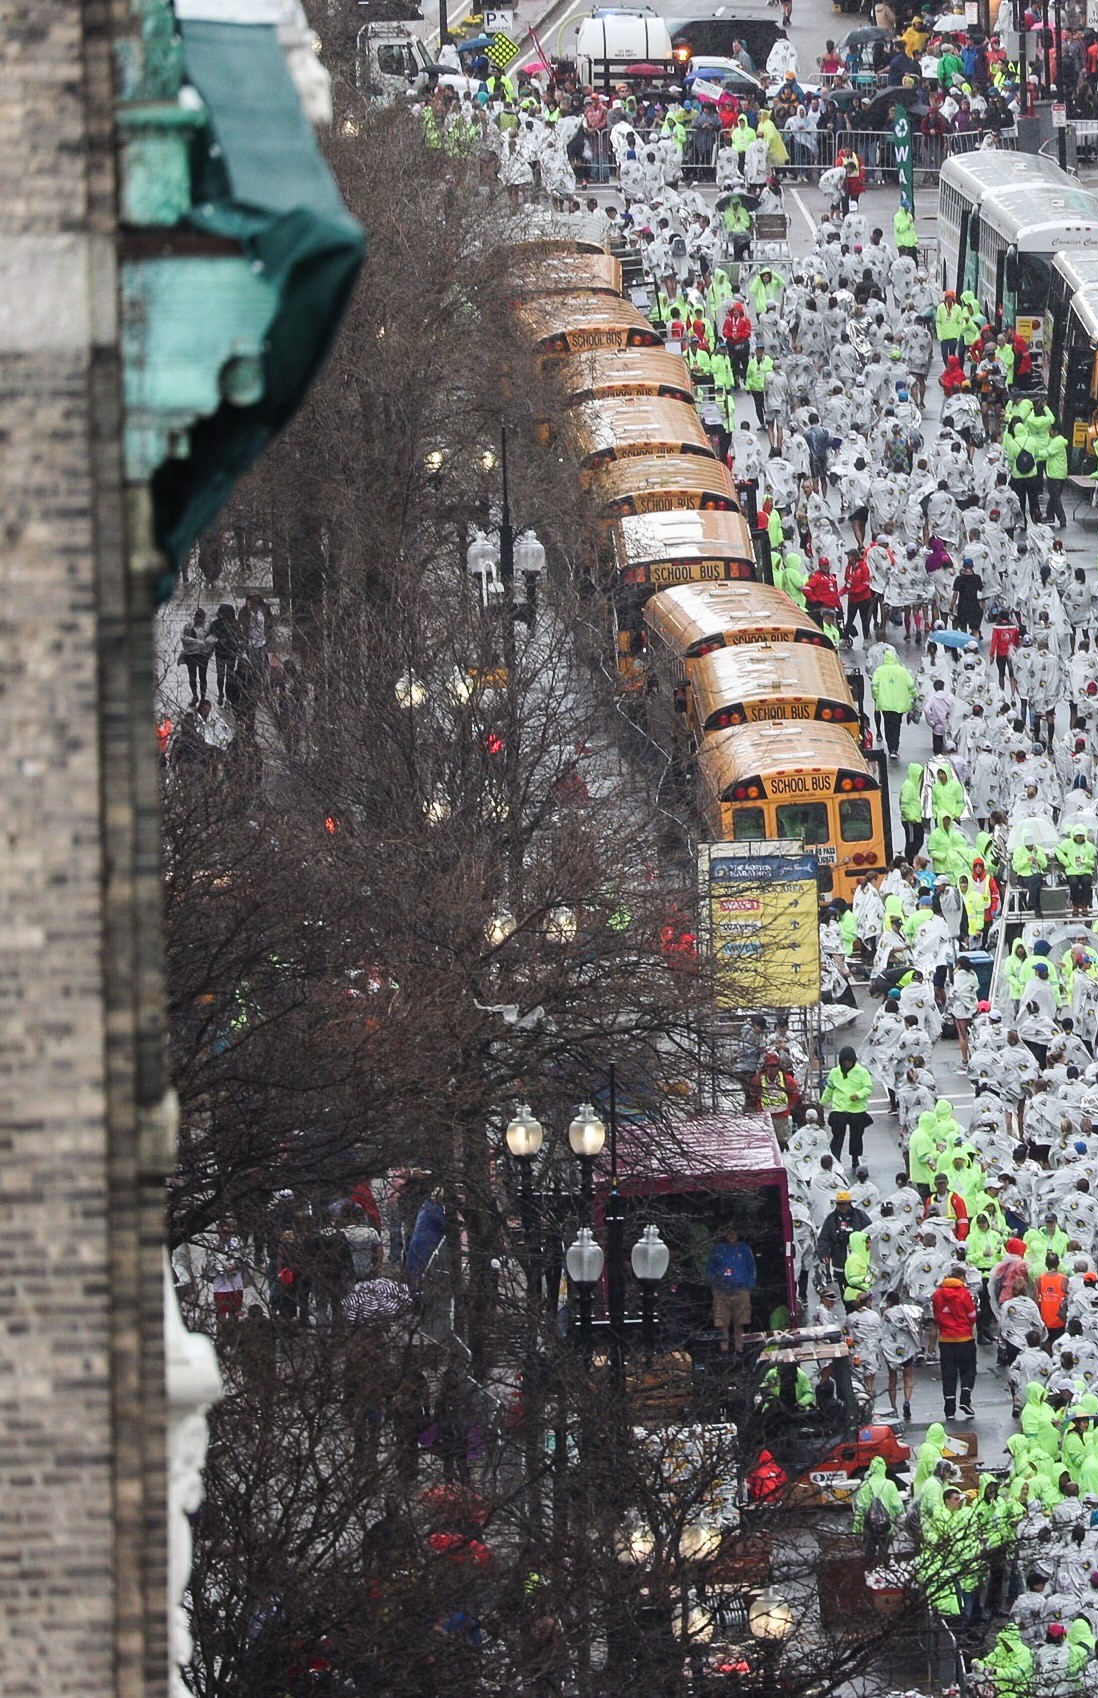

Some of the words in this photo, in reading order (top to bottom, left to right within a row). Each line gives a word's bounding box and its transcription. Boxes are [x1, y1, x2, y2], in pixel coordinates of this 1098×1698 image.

[572, 331, 605, 348] SCHOOL
[606, 332, 623, 345] BUS
[640, 498, 673, 513] SCHOOL
[677, 497, 695, 510] BUS
[654, 565, 694, 581] SCHOOL
[700, 564, 720, 579] BUS
[752, 704, 788, 722] SCHOOL
[791, 704, 810, 720] BUS
[771, 777, 809, 795] SCHOOL
[811, 775, 831, 791] BUS
[784, 884, 805, 893] AREA
